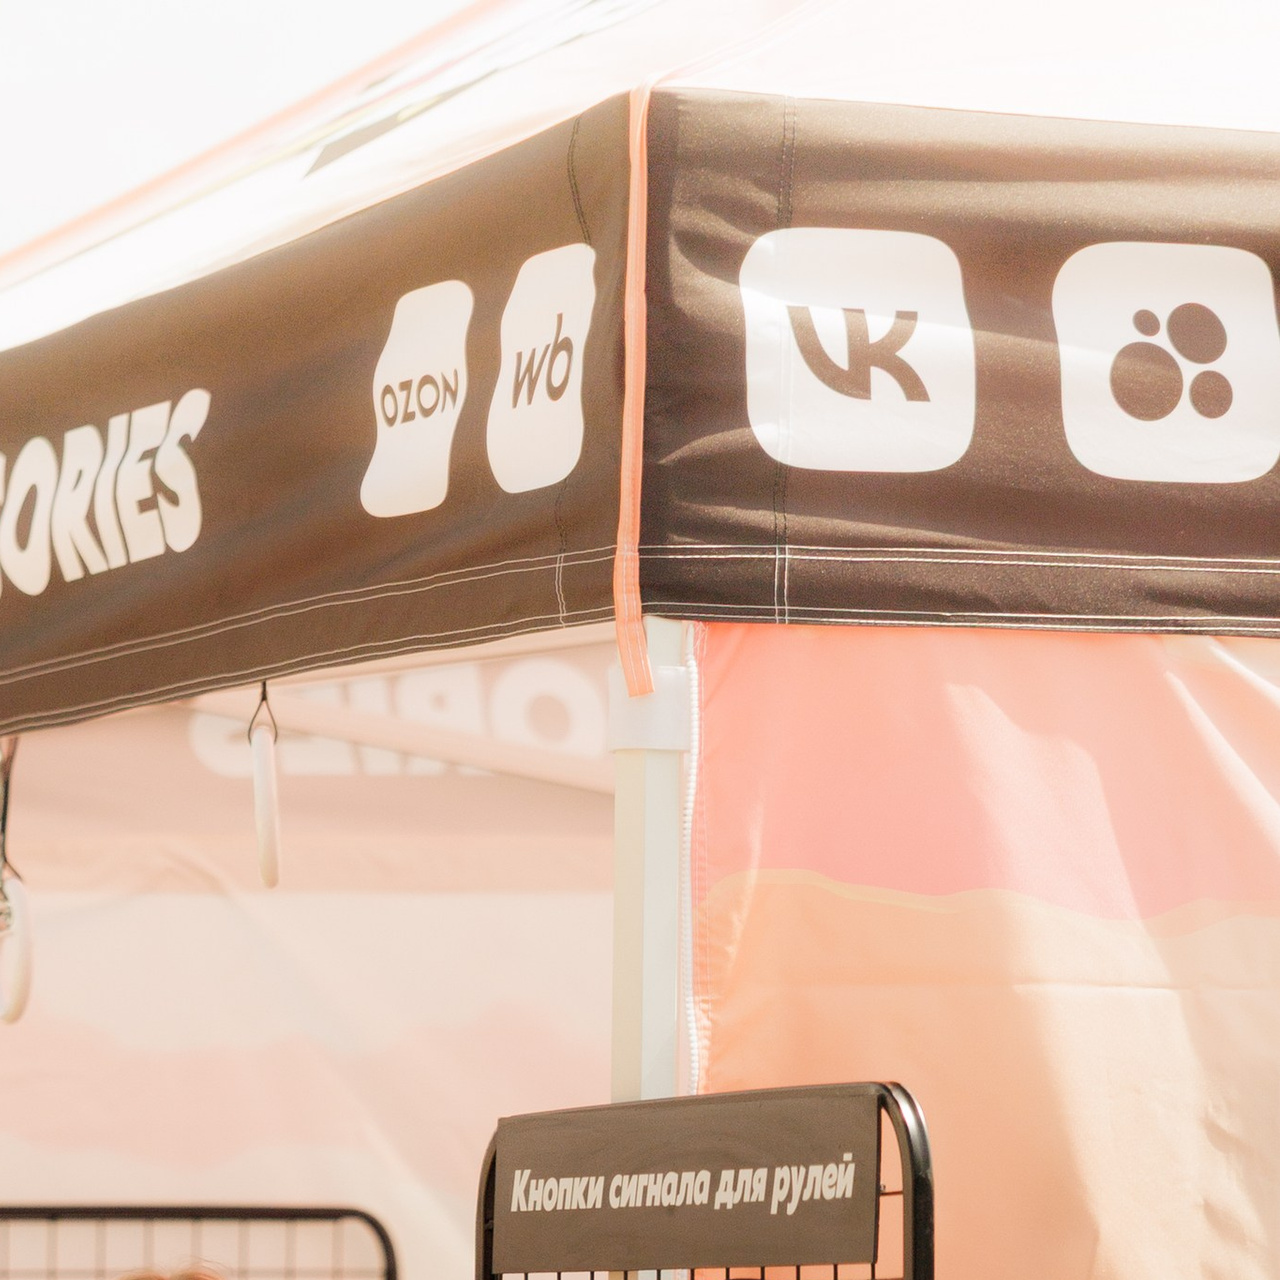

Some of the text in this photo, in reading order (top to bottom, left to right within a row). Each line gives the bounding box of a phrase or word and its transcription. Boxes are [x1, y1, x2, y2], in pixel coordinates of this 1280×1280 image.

[787, 305, 931, 403] VK
[380, 367, 459, 428] OZON
[510, 1152, 856, 1216] Кнопки сигнала для рулей
